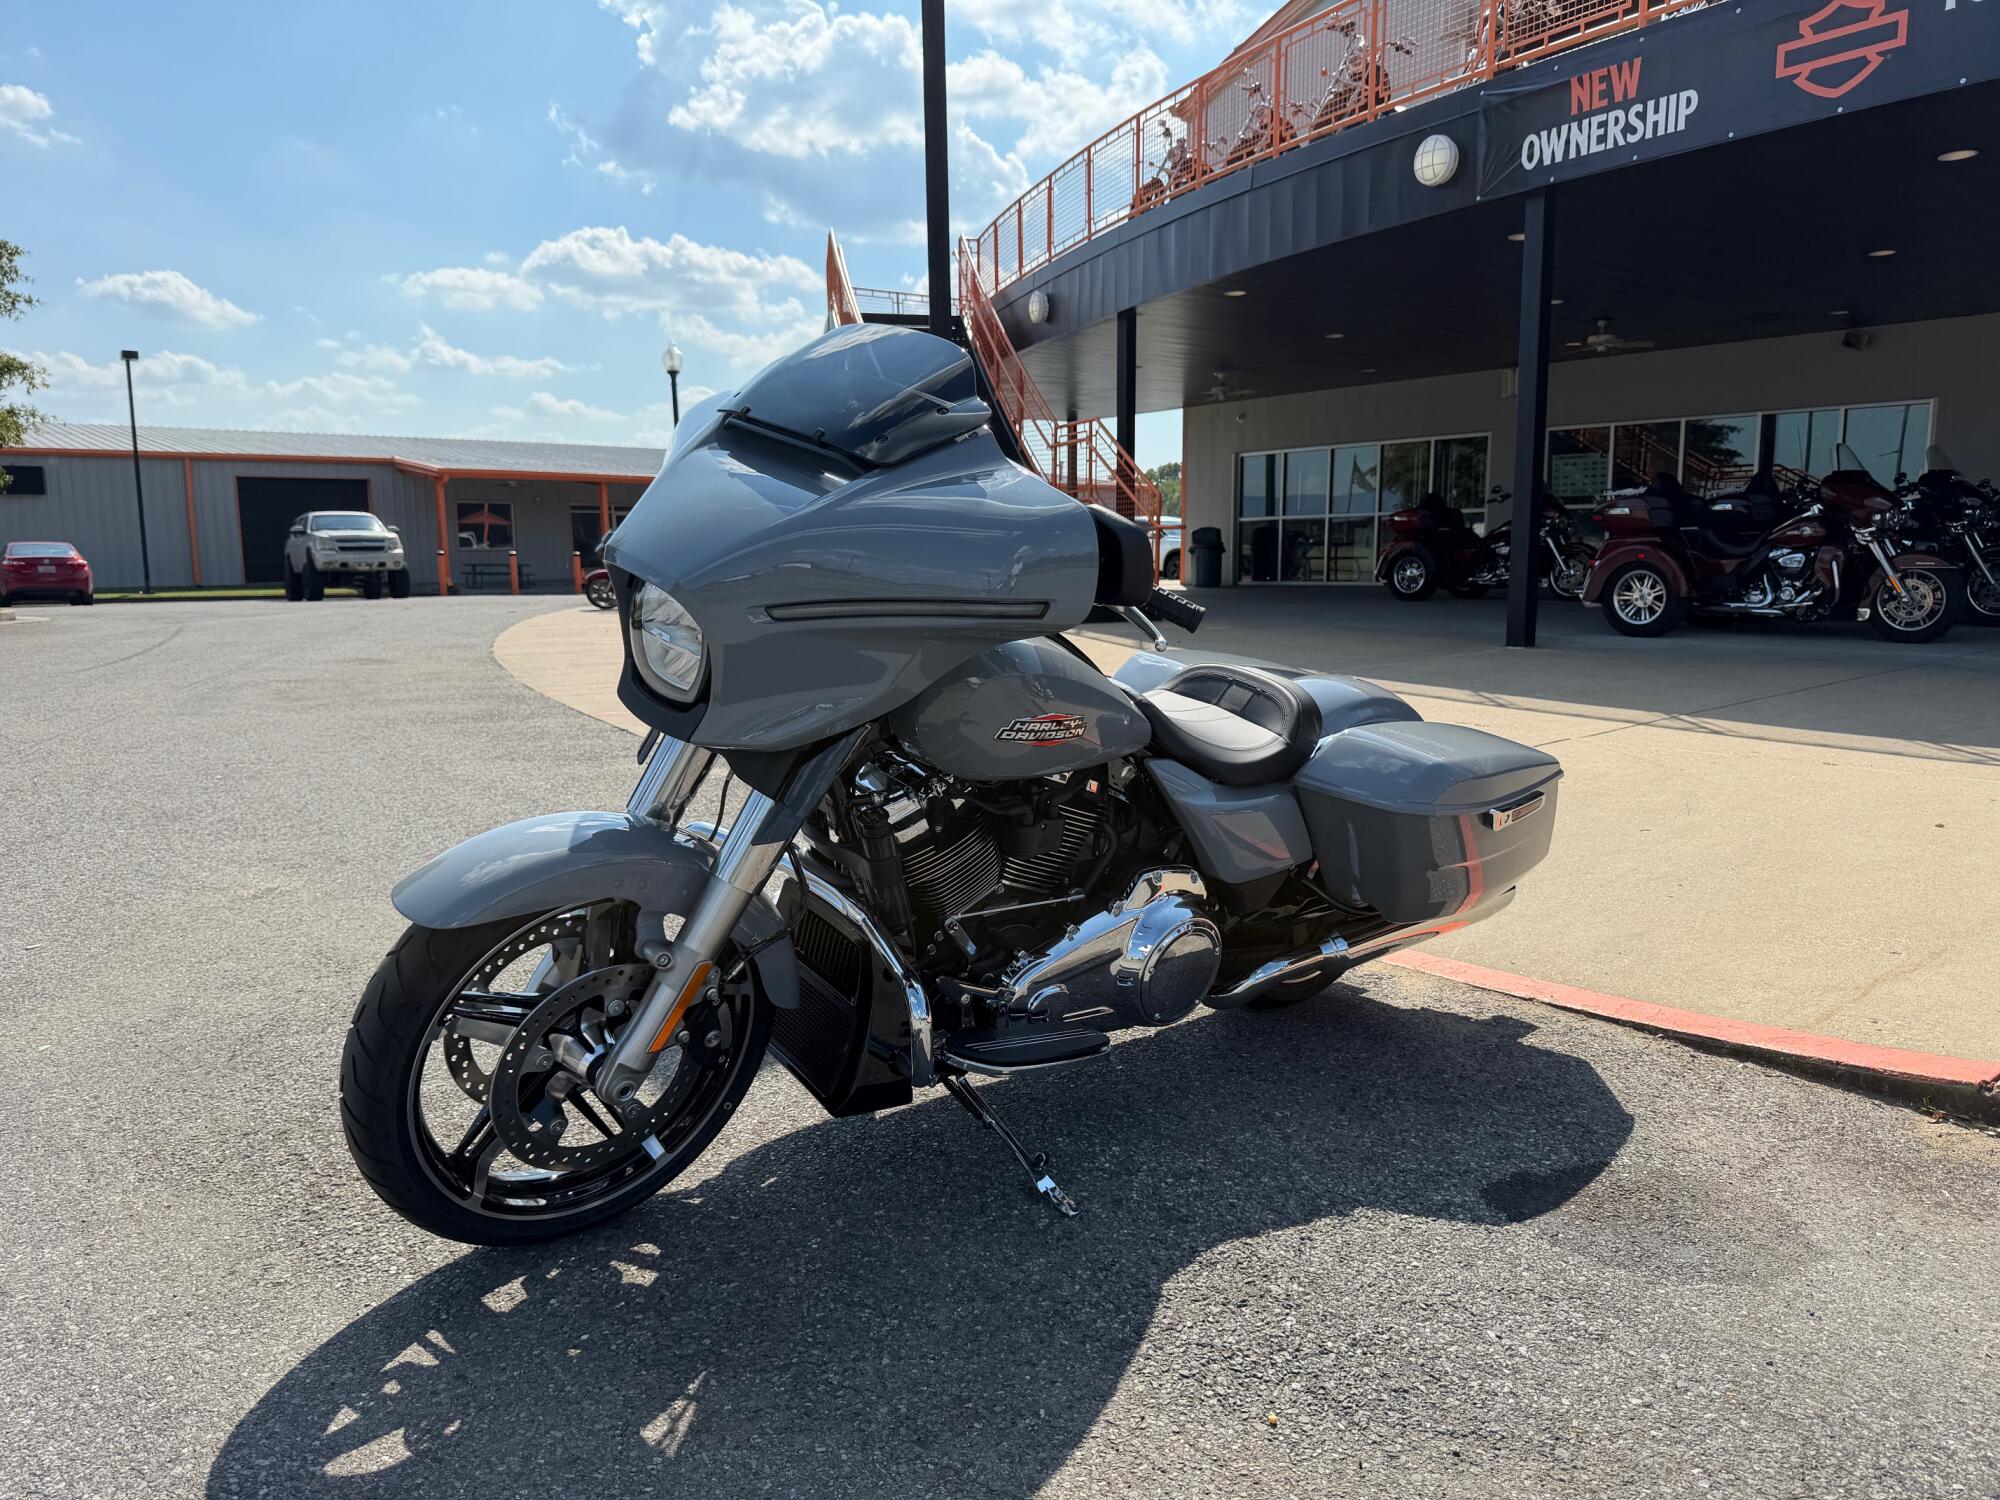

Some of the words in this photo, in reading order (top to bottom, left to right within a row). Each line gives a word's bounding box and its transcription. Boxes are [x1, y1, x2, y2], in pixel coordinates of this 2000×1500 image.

[1570, 56, 1642, 116] NEW
[1520, 89, 1699, 171] OWNERSHIP
[1000, 727, 1085, 740] DAVIDSON
